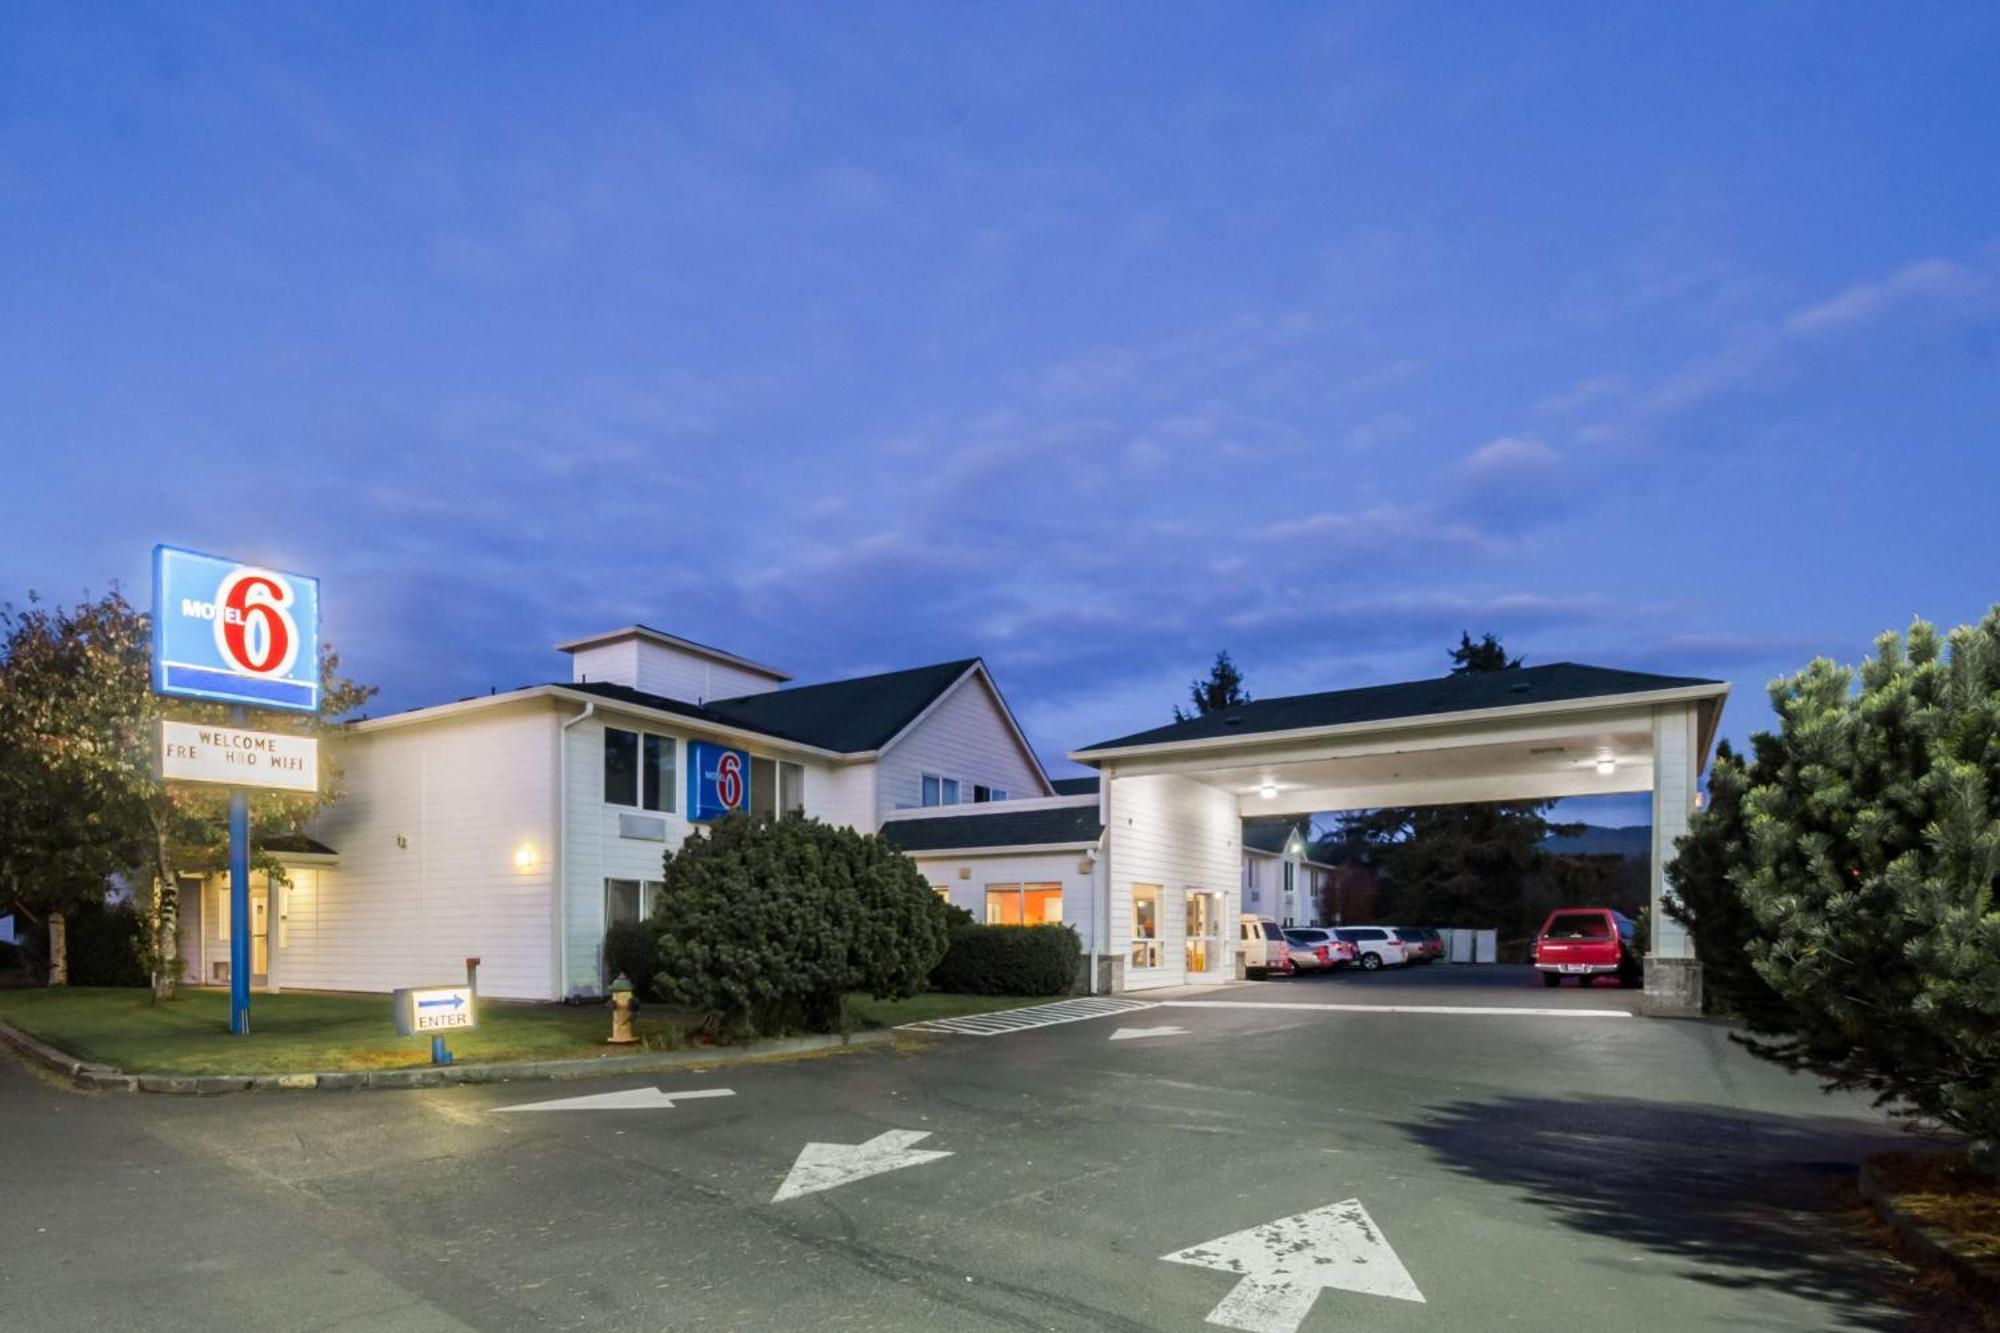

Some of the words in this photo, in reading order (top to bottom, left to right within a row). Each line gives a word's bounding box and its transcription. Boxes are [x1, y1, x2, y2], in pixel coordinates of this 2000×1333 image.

[217, 570, 296, 675] 6
[199, 731, 276, 753] WELCOME
[226, 750, 257, 766] HO
[271, 755, 304, 771] WIFI
[705, 768, 727, 783] MOEL
[718, 752, 742, 809] 6
[418, 1013, 467, 1029] ENTER
